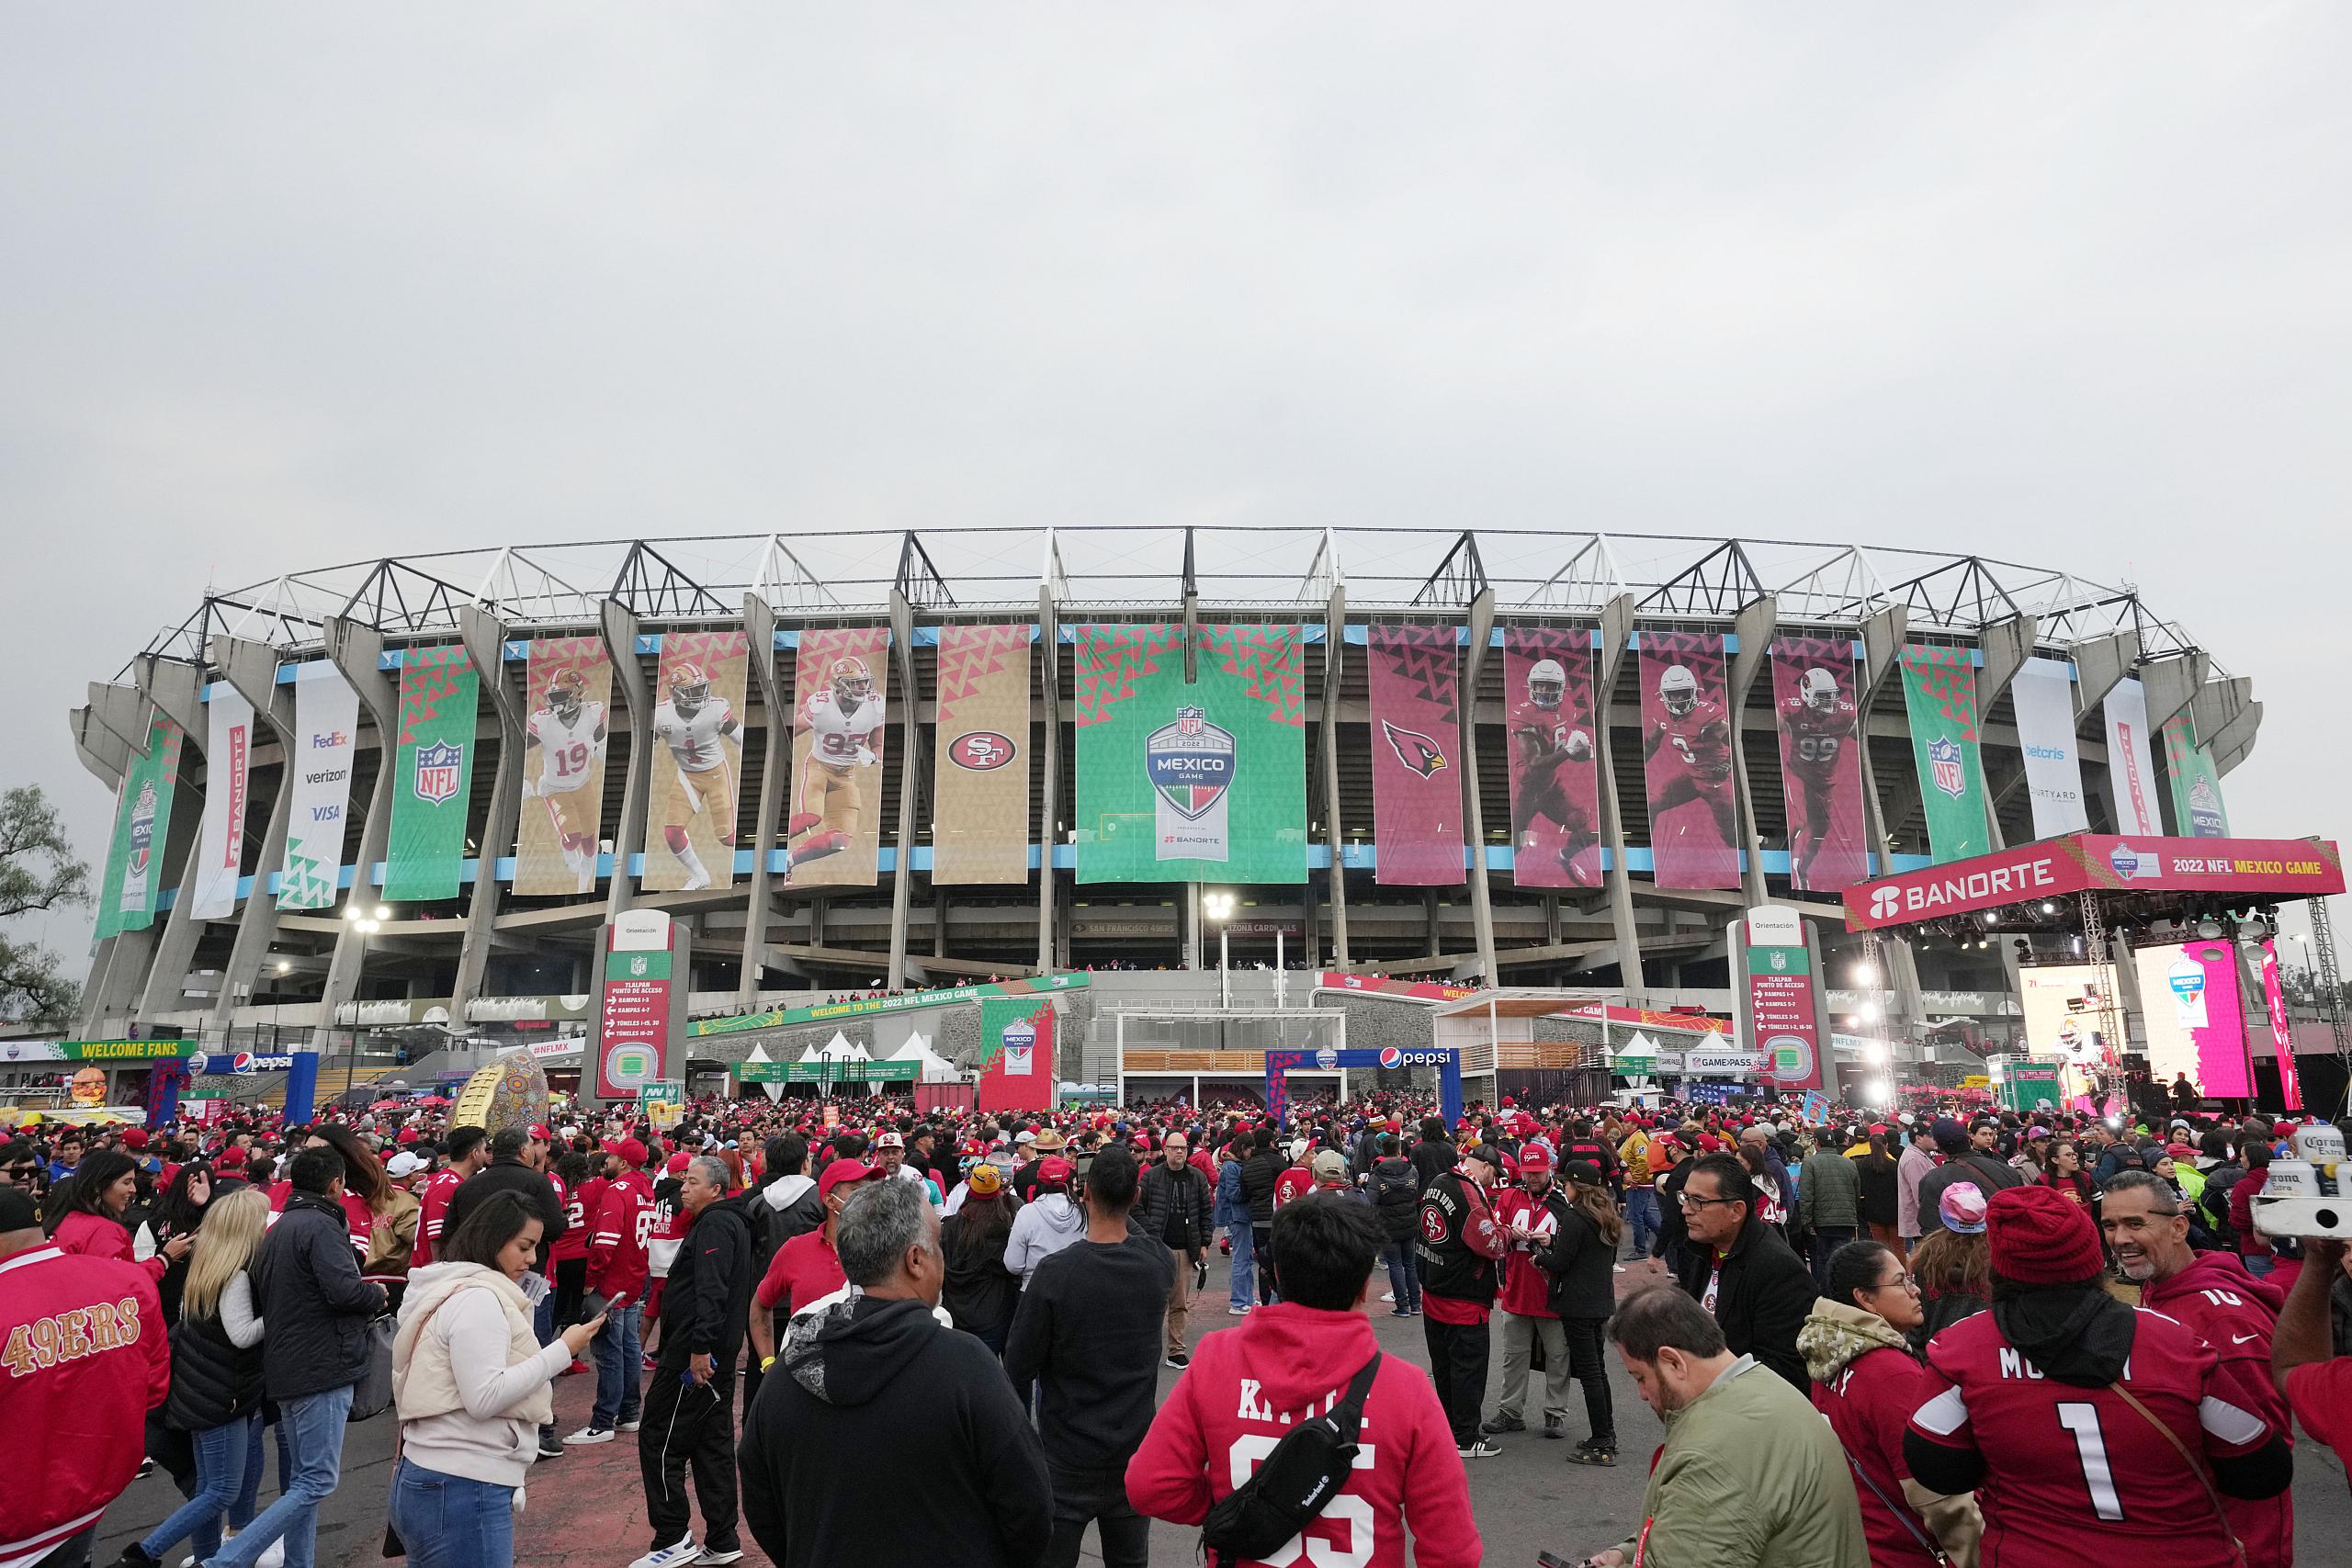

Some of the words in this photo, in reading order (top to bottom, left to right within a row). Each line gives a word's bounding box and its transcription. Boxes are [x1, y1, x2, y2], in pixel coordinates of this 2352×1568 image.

[1181, 719, 1202, 734] NFL
[313, 731, 347, 749] FedEx
[822, 733, 869, 755] 97
[1800, 738, 1838, 761] 99
[555, 742, 588, 777] 19
[684, 739, 705, 764] 1
[967, 737, 1004, 767] SF
[1672, 738, 1697, 763] 3
[2025, 743, 2064, 761] betcris
[1158, 758, 1225, 772] MEXICO
[1934, 762, 1963, 788] NFL
[233, 730, 243, 832] BANORTE
[306, 769, 346, 784] verizon
[420, 768, 457, 796] NFL
[2120, 728, 2148, 824] BANORTE
[311, 805, 340, 821] VISA
[2174, 859, 2205, 873] 2022
[2208, 859, 2233, 873] NFL
[2234, 860, 2283, 874] MEXICO
[2286, 861, 2323, 874] GAME
[1906, 858, 2054, 910] BANORTE
[1254, 923, 1296, 932] CARDIALS
[810, 1005, 851, 1018] WELCOME
[853, 1004, 864, 1013] TO
[865, 1000, 881, 1011] THE
[883, 998, 902, 1009] 2022
[904, 996, 920, 1006] NFL
[922, 991, 954, 1003] MEXICO
[955, 988, 978, 999] GAME
[1442, 989, 1472, 999] WELCO
[1584, 1007, 1602, 1016] GAM
[81, 1043, 144, 1057] WELCOME
[147, 1043, 178, 1055] FANS
[534, 1043, 569, 1055] #NFLMX
[1403, 1047, 1451, 1066] pepsi
[251, 1054, 294, 1071] pepsi
[1572, 1145, 1600, 1153] MONTANA
[2318, 1147, 2342, 1156] Extra
[1439, 1192, 1457, 1216] BOWL
[1, 1297, 141, 1378] 49ERS
[2055, 1402, 2124, 1521] 1
[1302, 1480, 1325, 1507] Timberland
